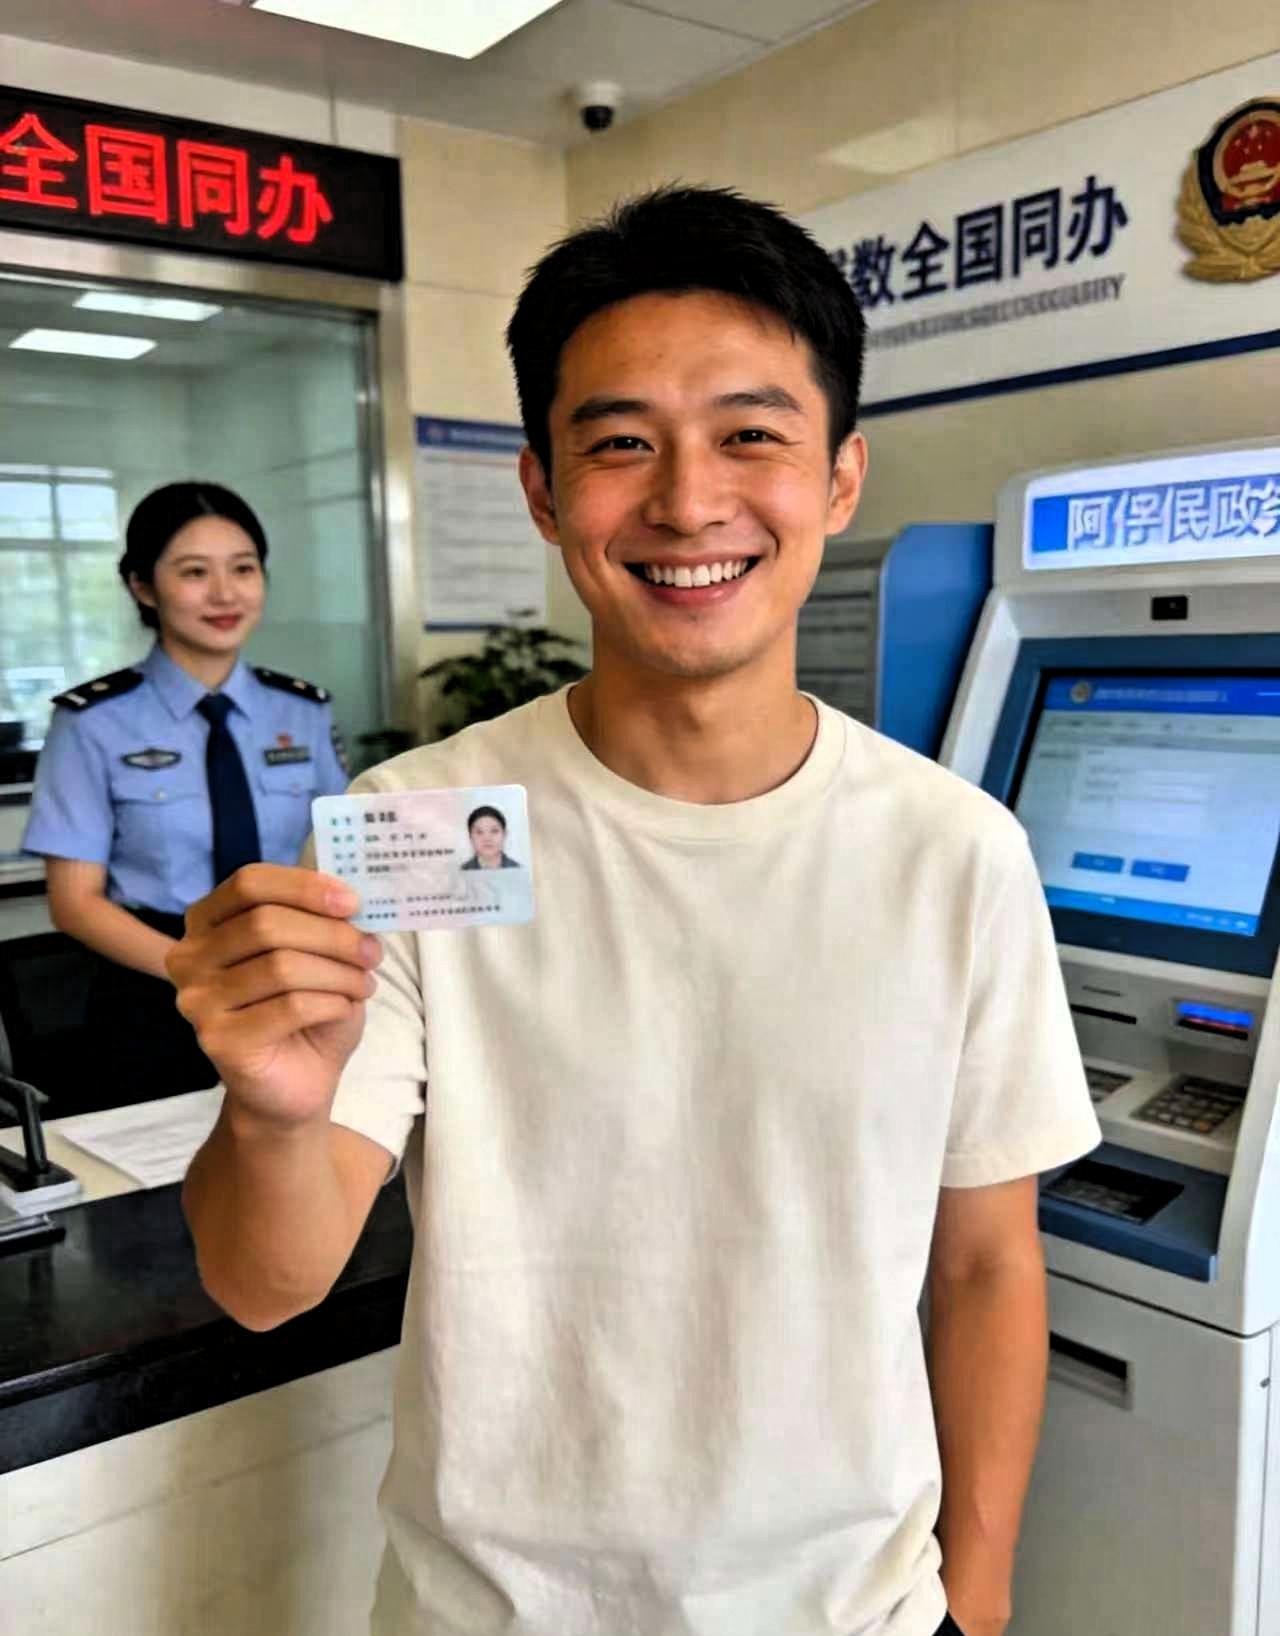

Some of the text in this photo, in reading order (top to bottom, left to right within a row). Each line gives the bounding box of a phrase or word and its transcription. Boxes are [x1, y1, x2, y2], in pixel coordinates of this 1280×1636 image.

[0, 113, 333, 243] 全国同办
[831, 175, 1129, 308] 数全国同办
